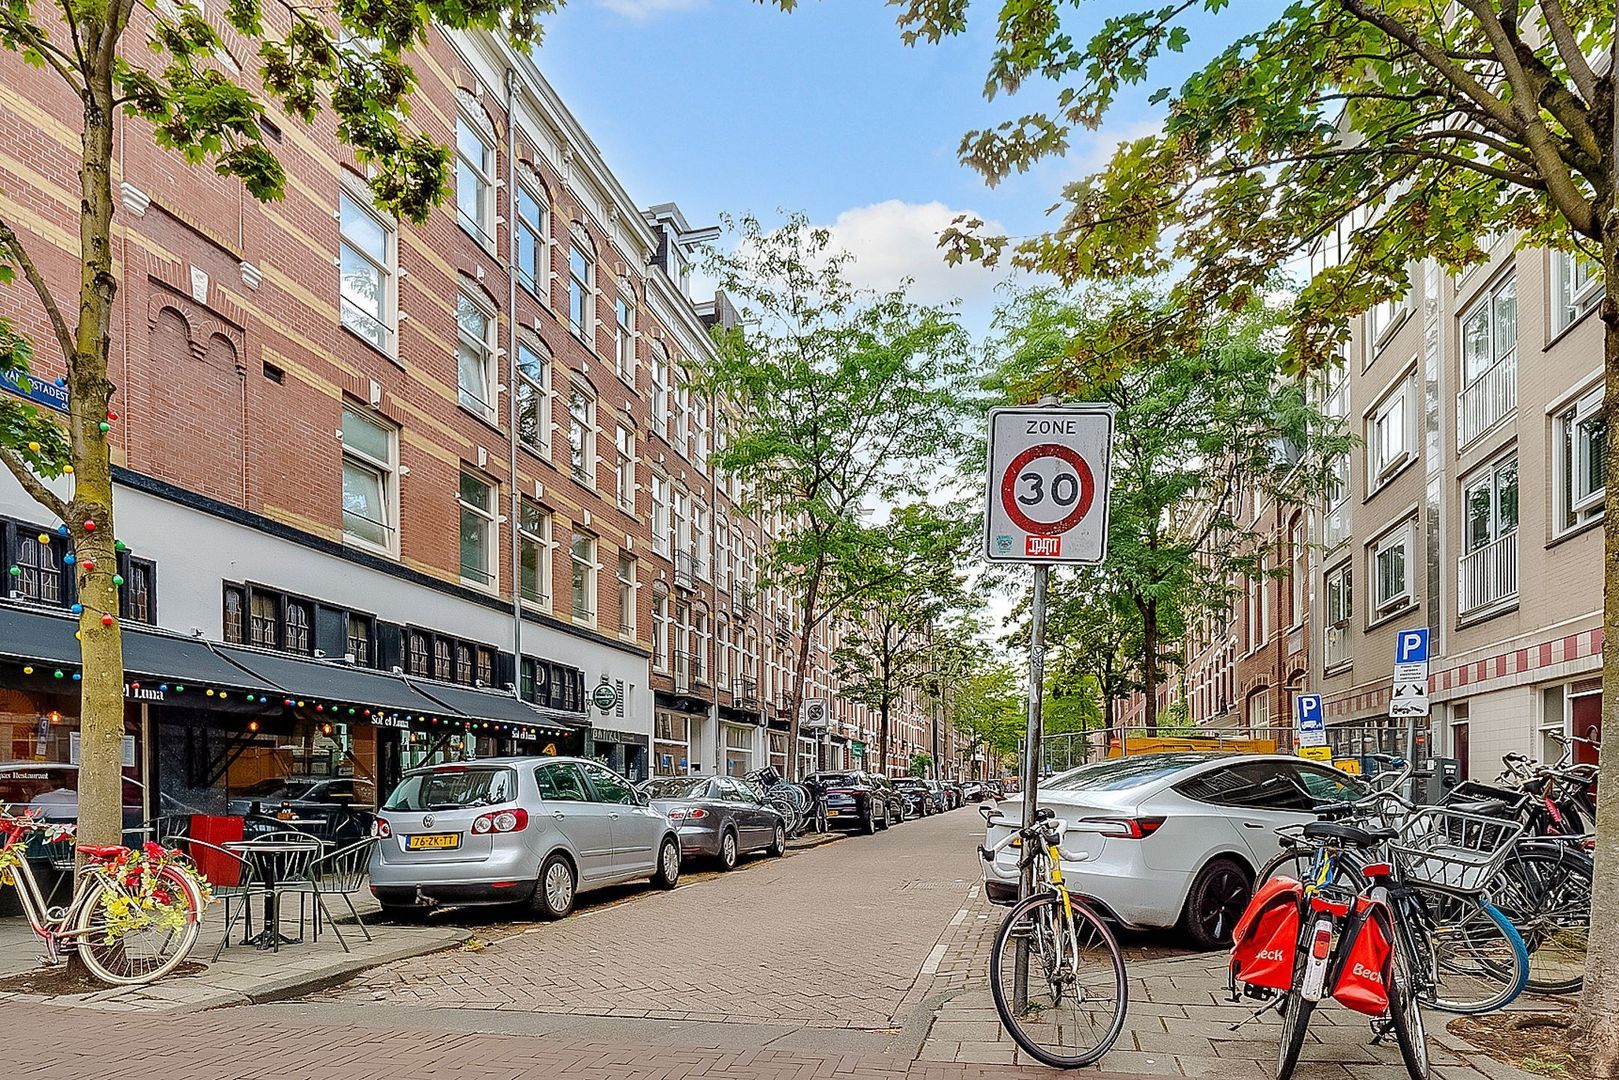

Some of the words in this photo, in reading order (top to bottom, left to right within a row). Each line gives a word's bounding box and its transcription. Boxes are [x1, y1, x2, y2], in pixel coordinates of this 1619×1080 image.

[27, 378, 70, 402] OSTADEST
[1026, 420, 1077, 435] ZONE
[1018, 472, 1079, 506] 30
[1402, 633, 1421, 660] P
[134, 686, 165, 701] Luna
[1301, 697, 1317, 718] P
[371, 714, 384, 725] Sol
[414, 836, 454, 847] 76-ZK-TT
